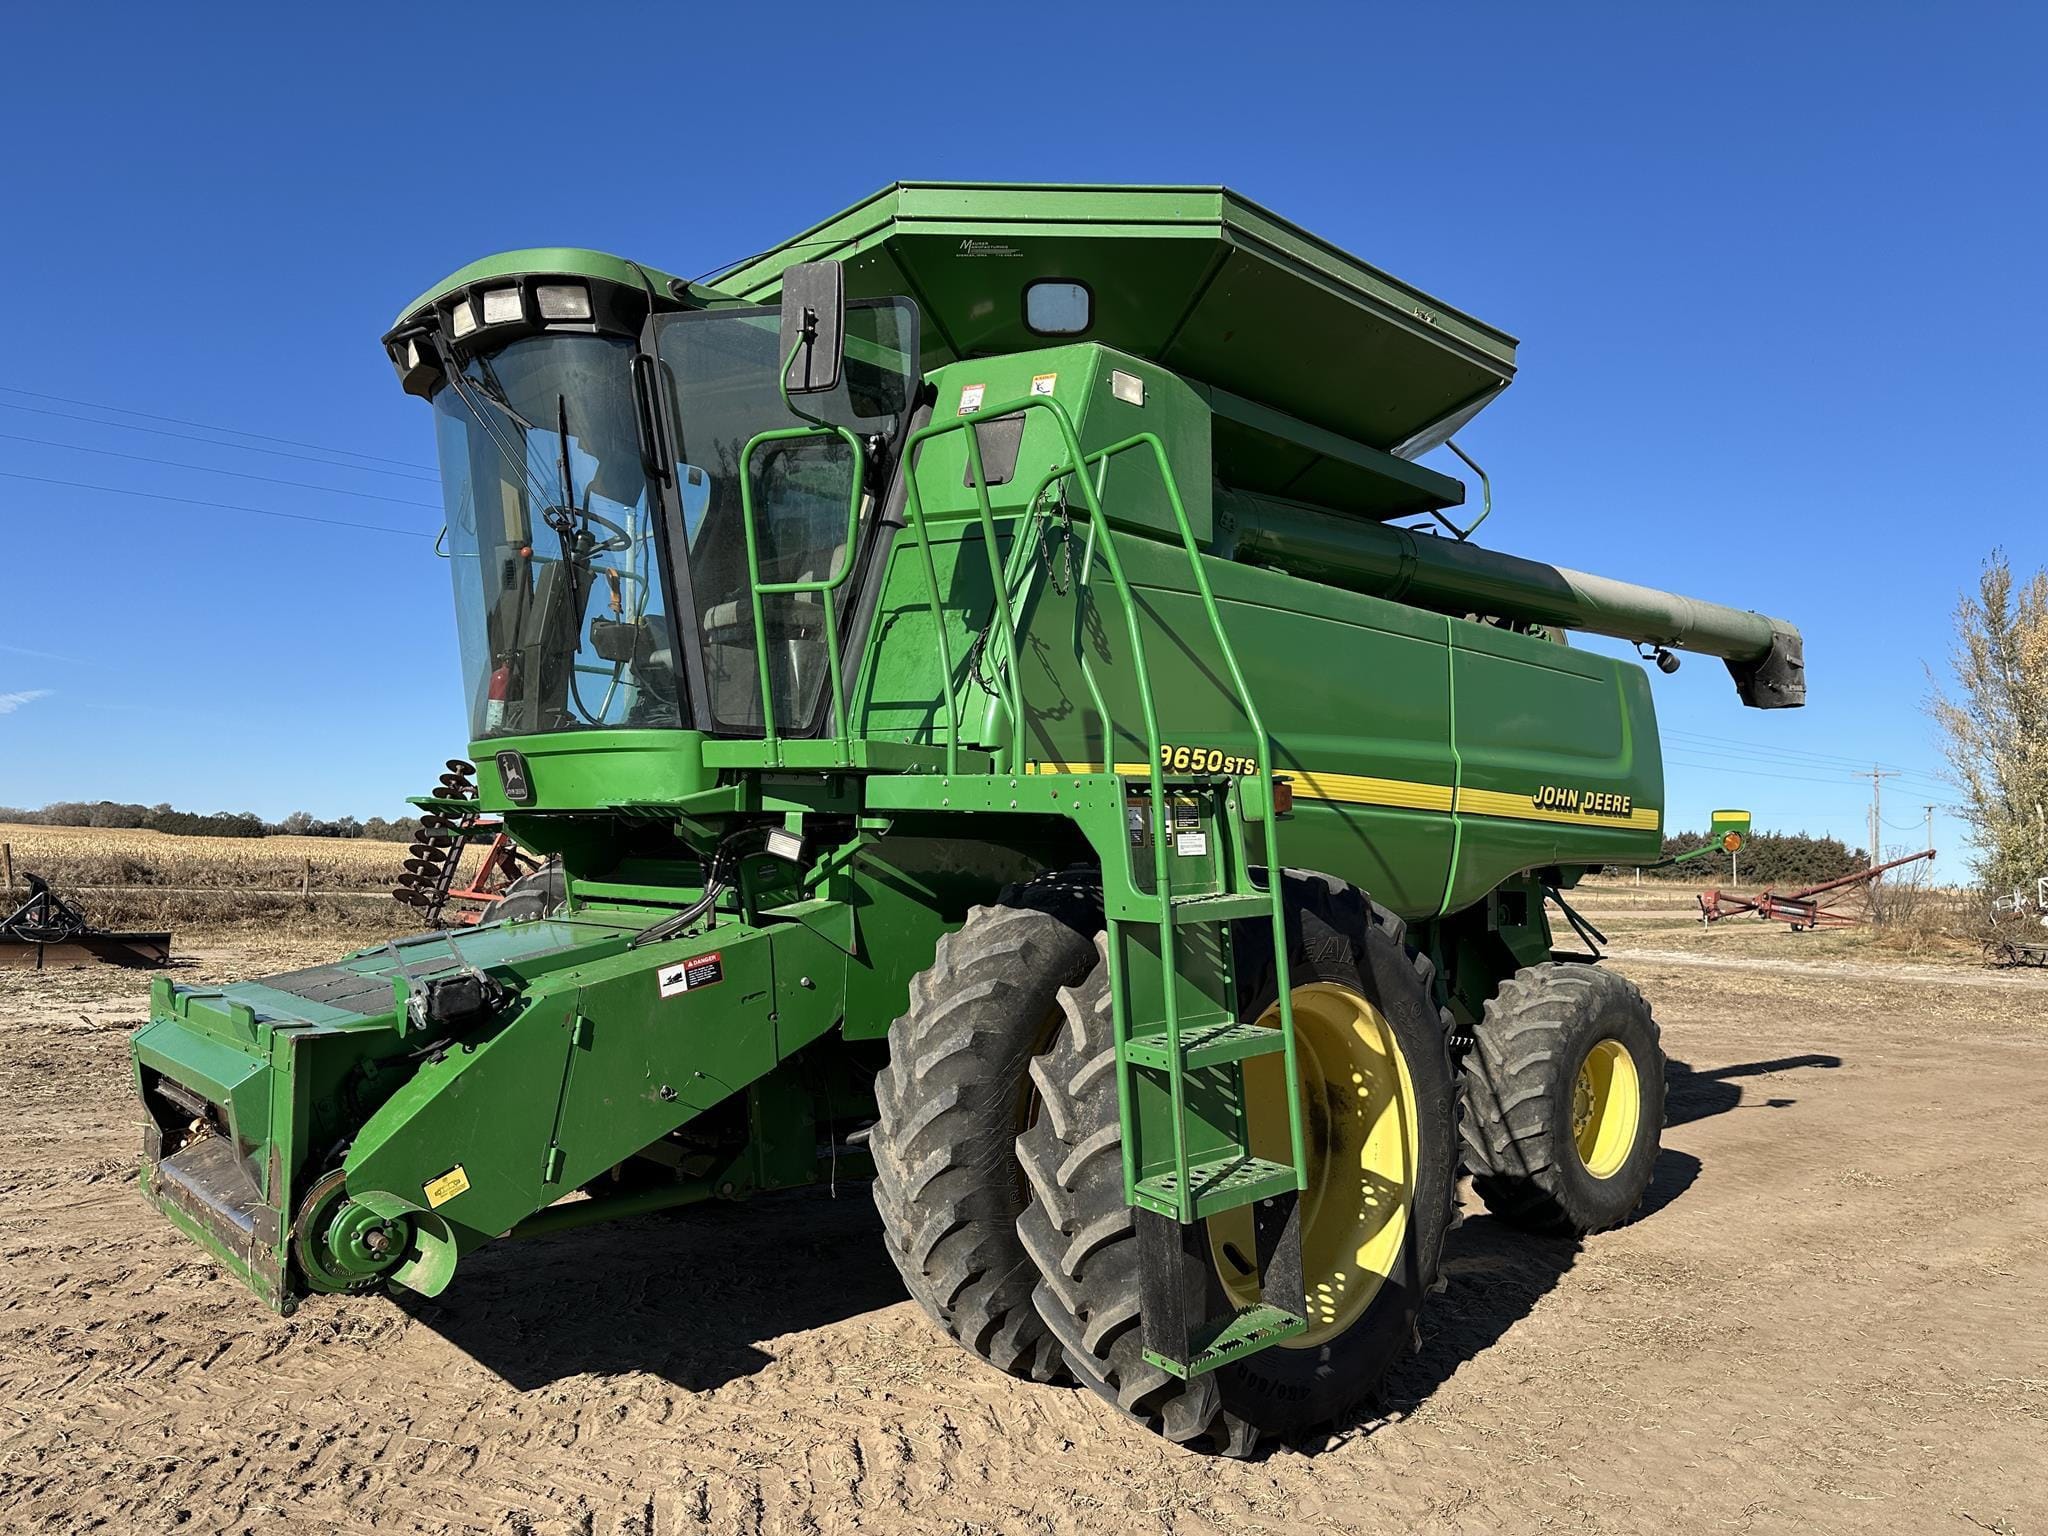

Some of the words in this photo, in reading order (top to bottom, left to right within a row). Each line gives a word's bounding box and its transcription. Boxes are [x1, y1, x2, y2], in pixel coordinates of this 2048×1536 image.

[1532, 785, 1579, 809] JOHN
[1583, 791, 1631, 814] DEERE
[693, 955, 717, 966] DANGER
